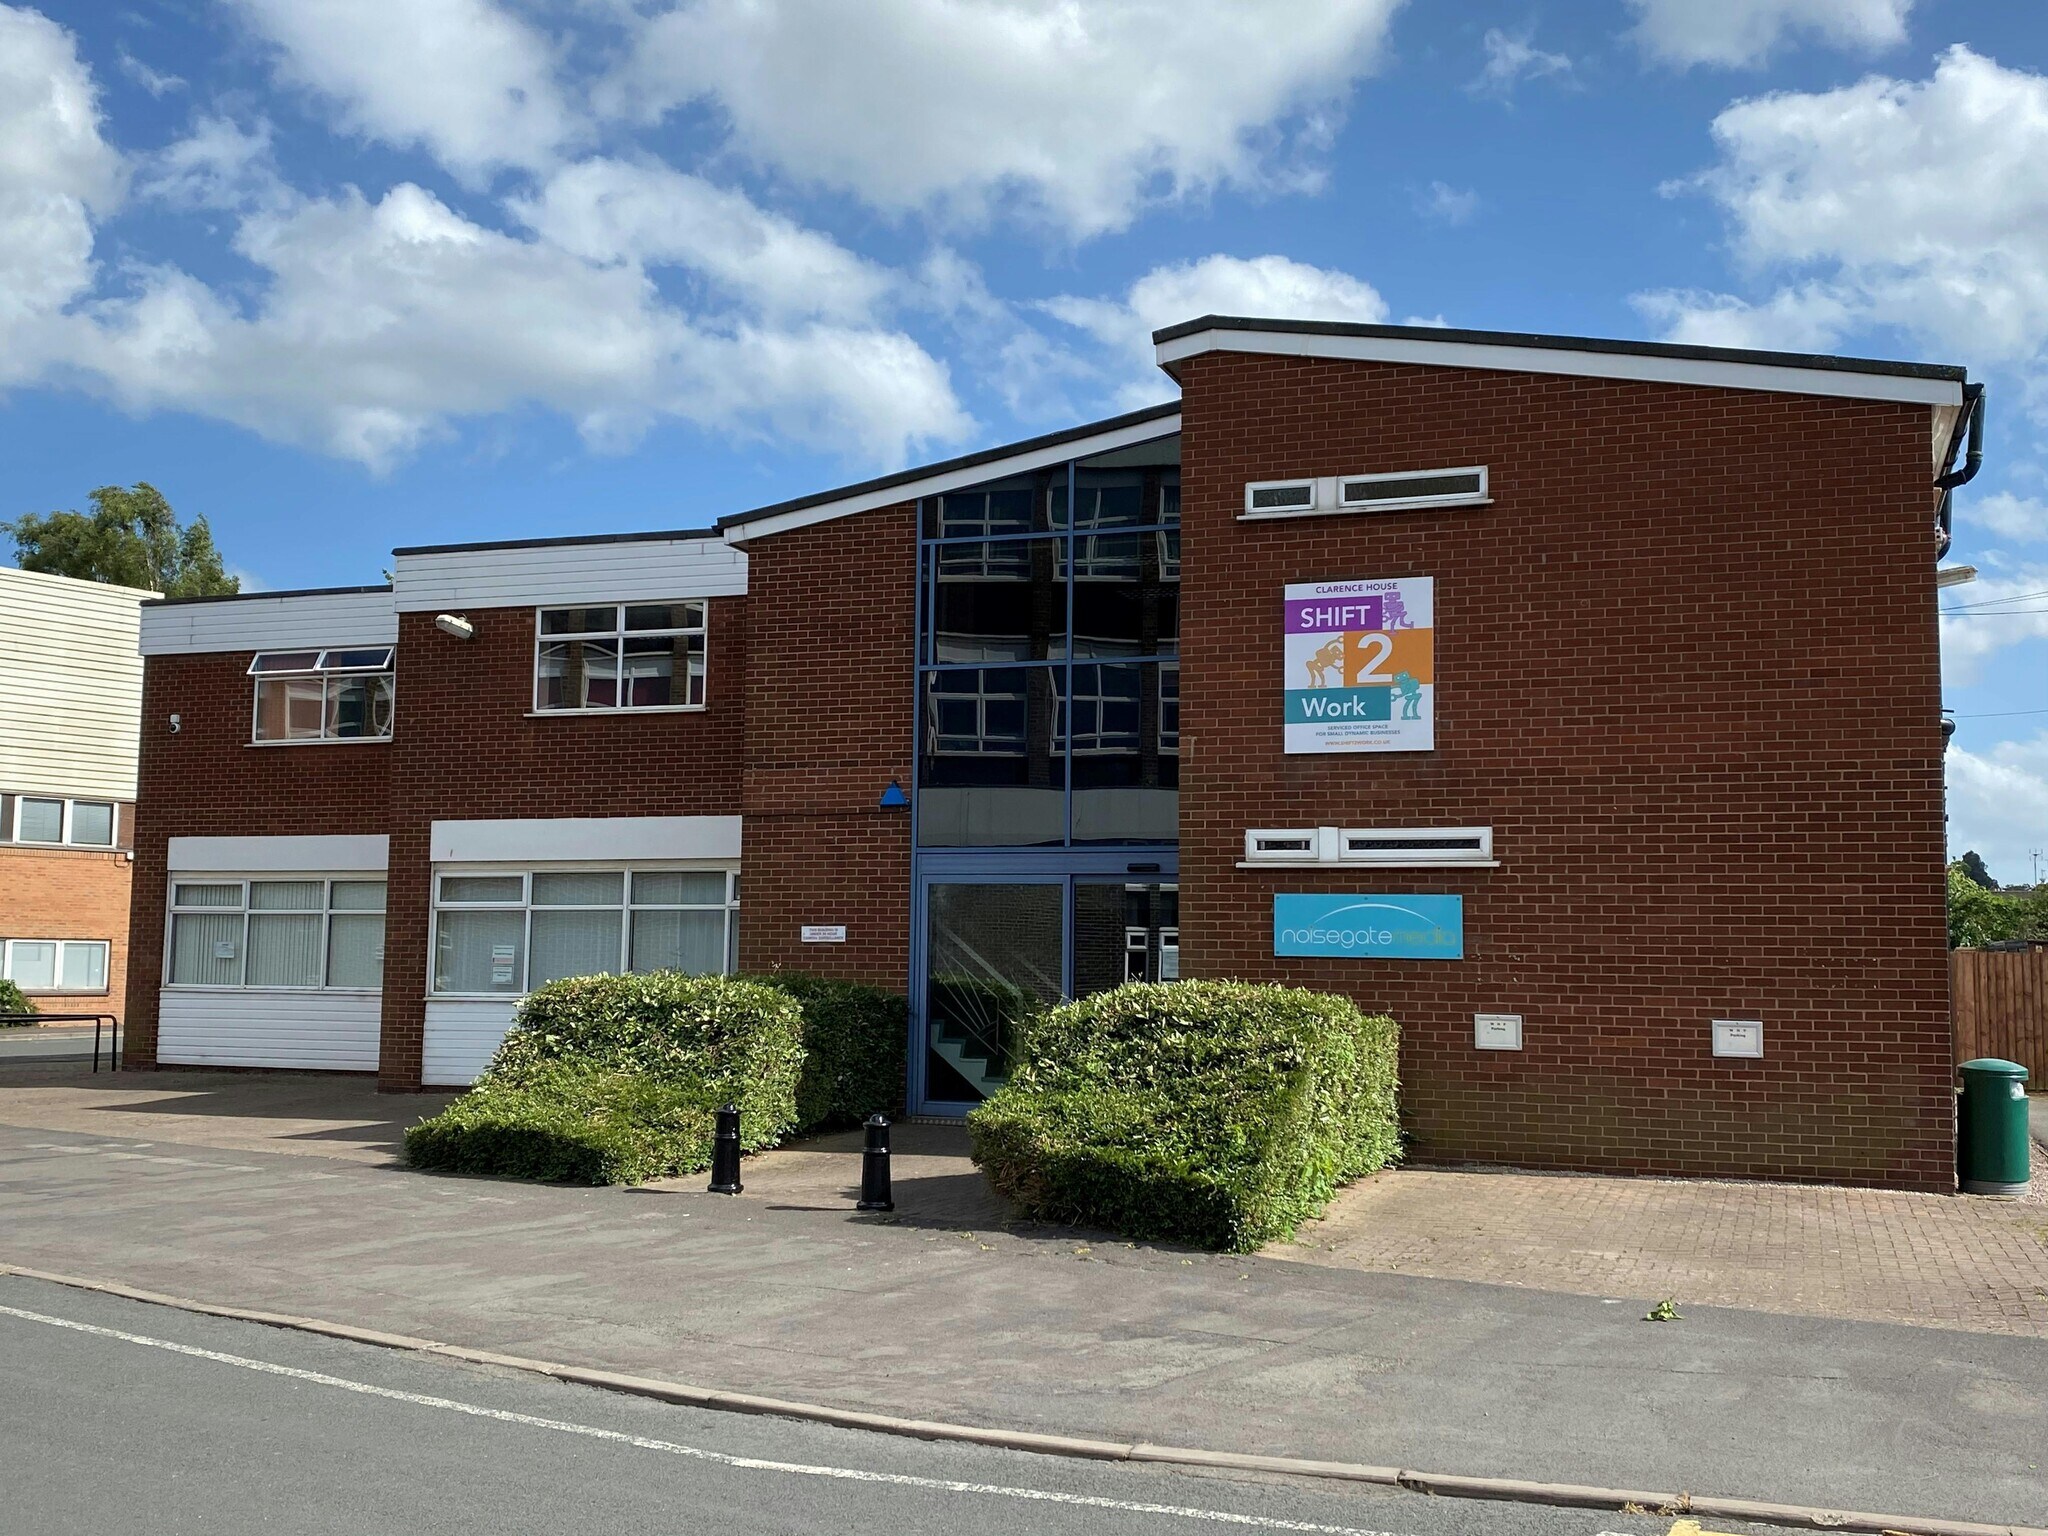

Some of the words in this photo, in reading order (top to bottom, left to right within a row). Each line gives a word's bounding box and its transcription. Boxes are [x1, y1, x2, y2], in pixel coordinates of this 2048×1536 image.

[1315, 584, 1364, 594] CLARENCE
[1366, 582, 1398, 591] HOUSE
[1300, 605, 1371, 628] SHIFT
[1356, 633, 1393, 683] 2
[1301, 695, 1366, 717] Work
